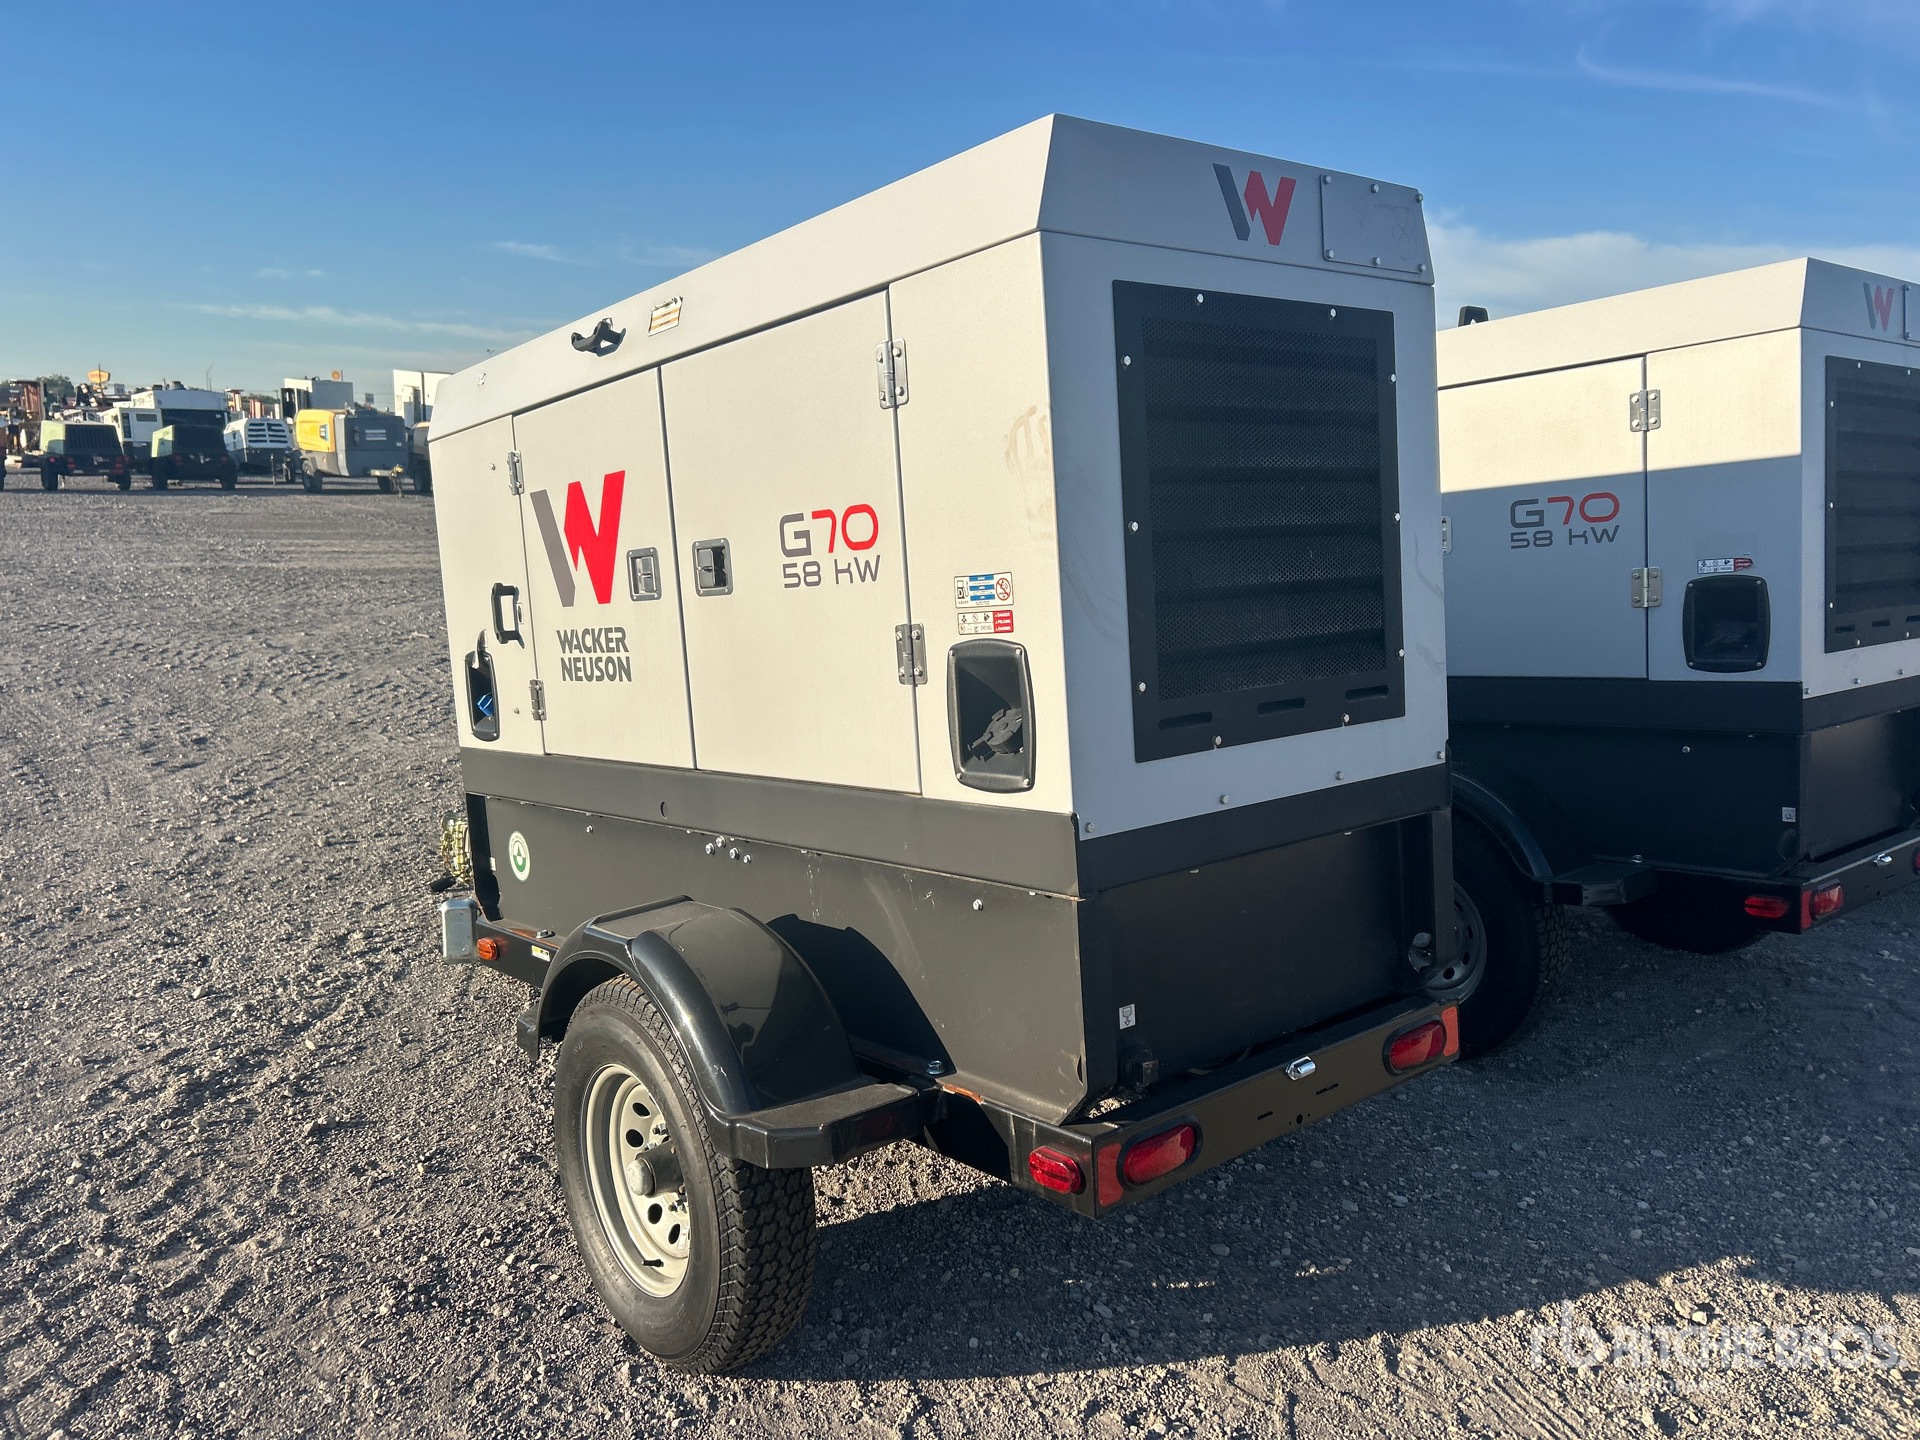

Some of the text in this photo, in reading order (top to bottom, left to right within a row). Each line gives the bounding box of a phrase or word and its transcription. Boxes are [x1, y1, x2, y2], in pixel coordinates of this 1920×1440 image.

[1510, 492, 1620, 529] G70
[779, 503, 879, 558] G70
[1510, 529, 1553, 549] 58
[782, 560, 822, 589] 58
[556, 626, 630, 654] WACKER
[560, 655, 633, 683] NEUSON
